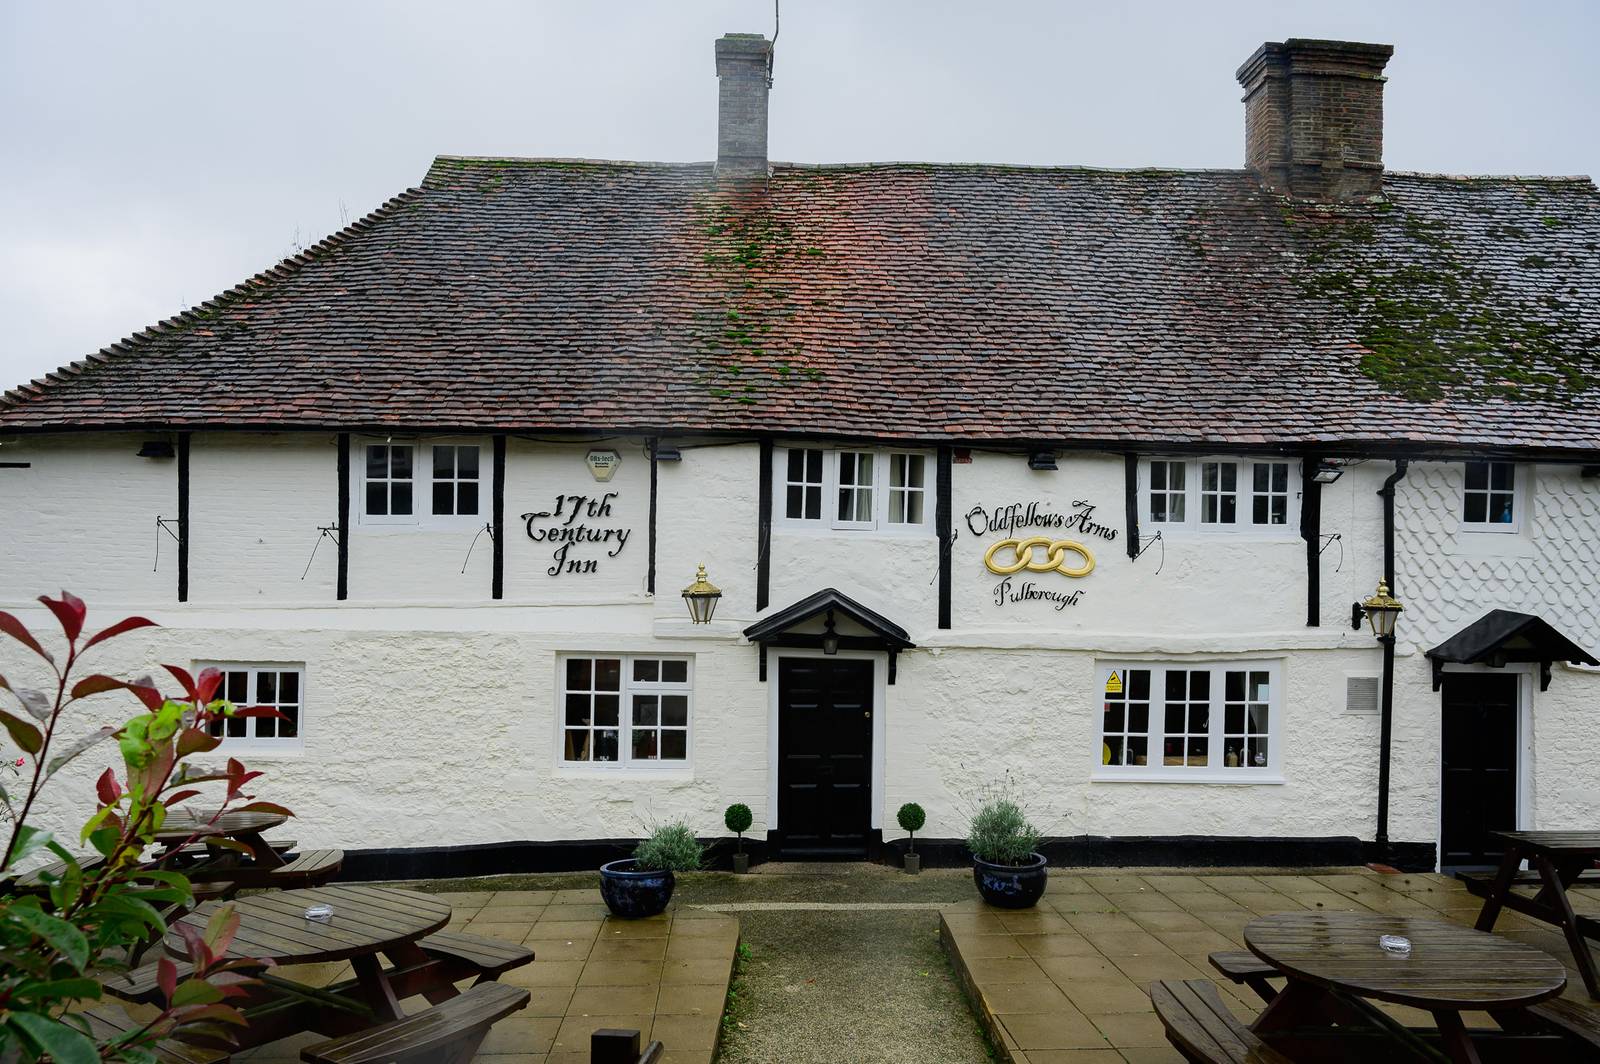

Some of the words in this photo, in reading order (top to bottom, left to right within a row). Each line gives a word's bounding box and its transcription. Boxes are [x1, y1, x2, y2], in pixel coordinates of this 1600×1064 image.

[554, 491, 619, 526] 17th
[965, 502, 1064, 539] Oddfellows
[1065, 500, 1119, 541] Arms
[520, 511, 631, 557] Century
[547, 541, 598, 576] Inn
[993, 576, 1086, 611] Pulborough
